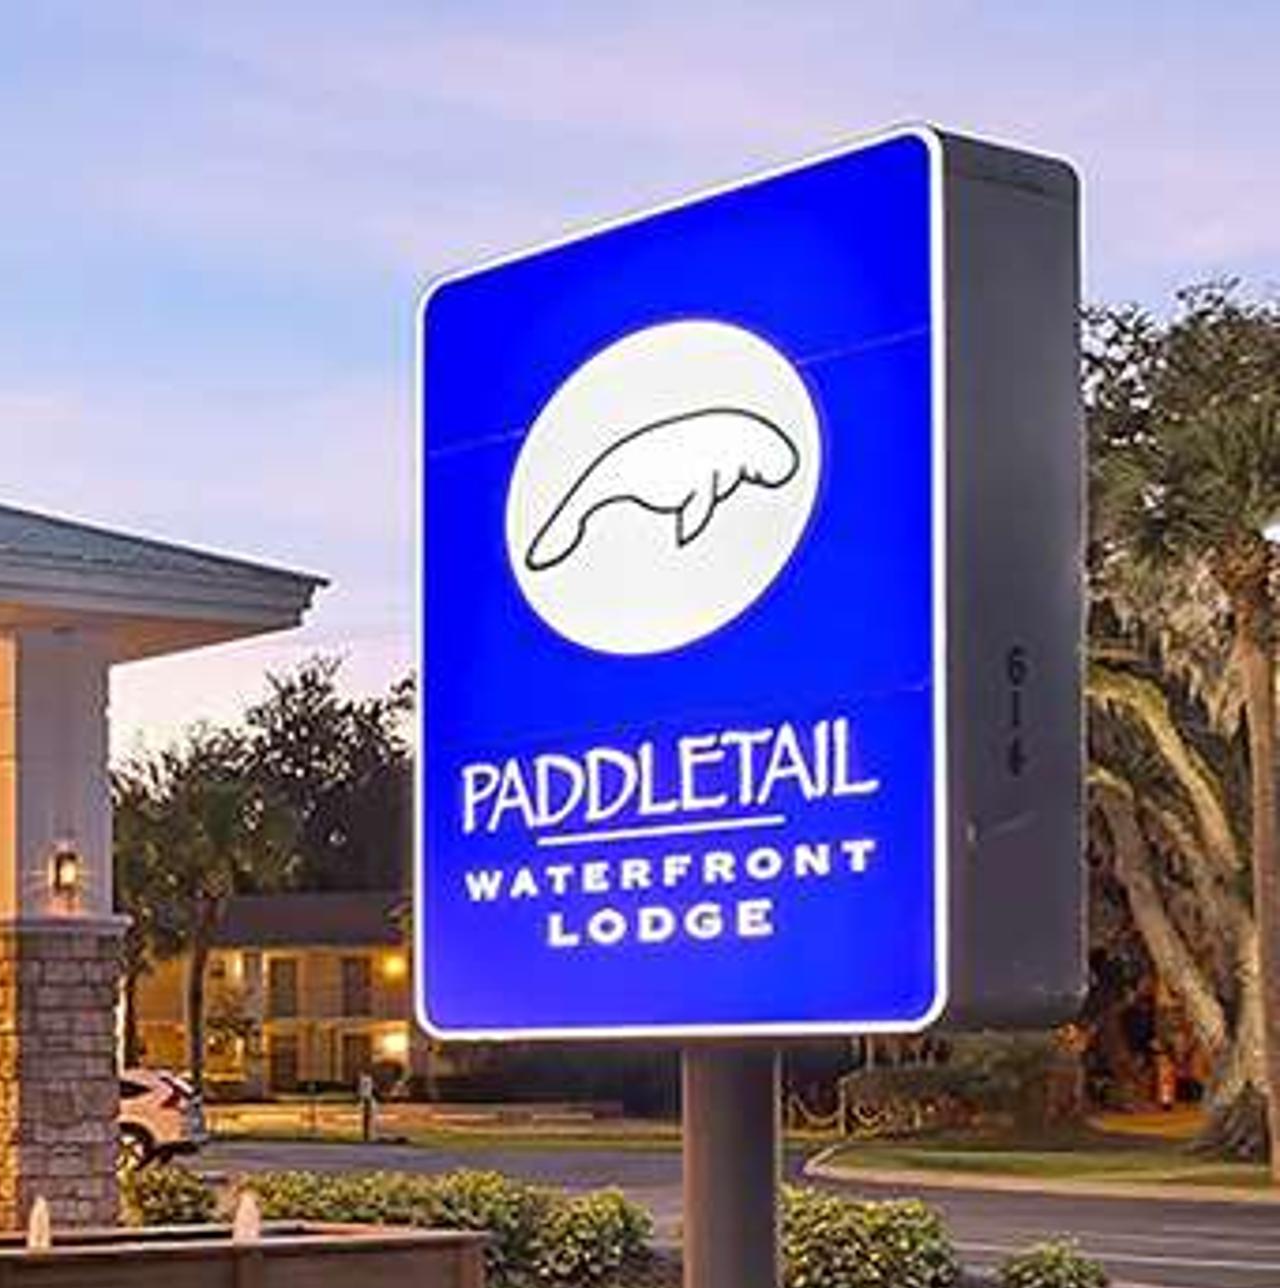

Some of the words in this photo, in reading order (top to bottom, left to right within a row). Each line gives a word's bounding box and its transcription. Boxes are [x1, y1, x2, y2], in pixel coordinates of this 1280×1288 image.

[461, 717, 879, 834] PADDLETAIL
[465, 839, 876, 902] WATERFRONT
[547, 899, 774, 947] LODGE
